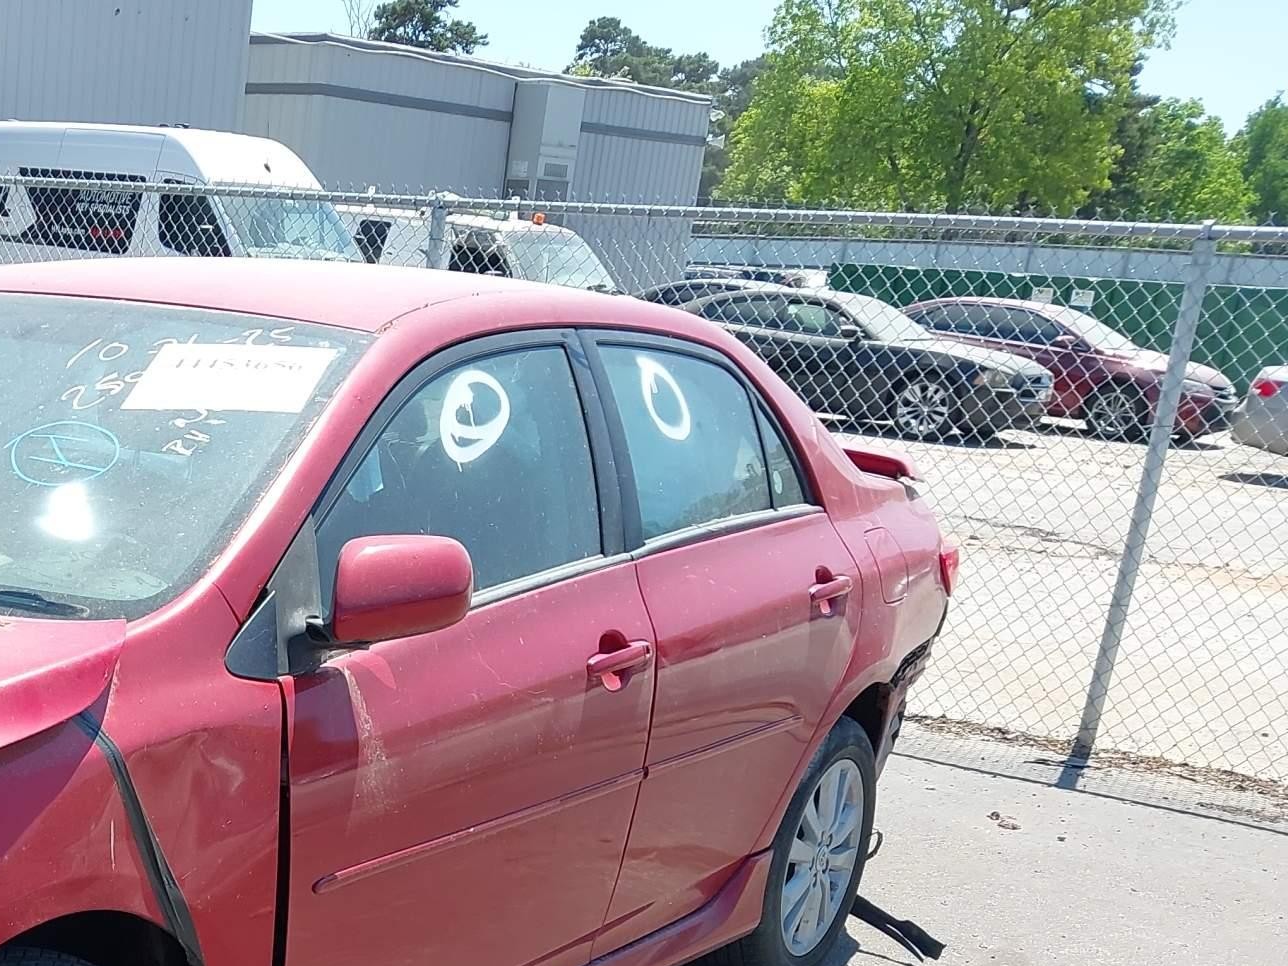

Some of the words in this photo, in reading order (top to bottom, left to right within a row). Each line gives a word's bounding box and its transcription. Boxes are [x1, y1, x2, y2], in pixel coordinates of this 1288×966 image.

[79, 190, 133, 205] AUTOMOTIVE
[75, 202, 90, 212] KEY
[90, 203, 131, 215] SPECIALISTS
